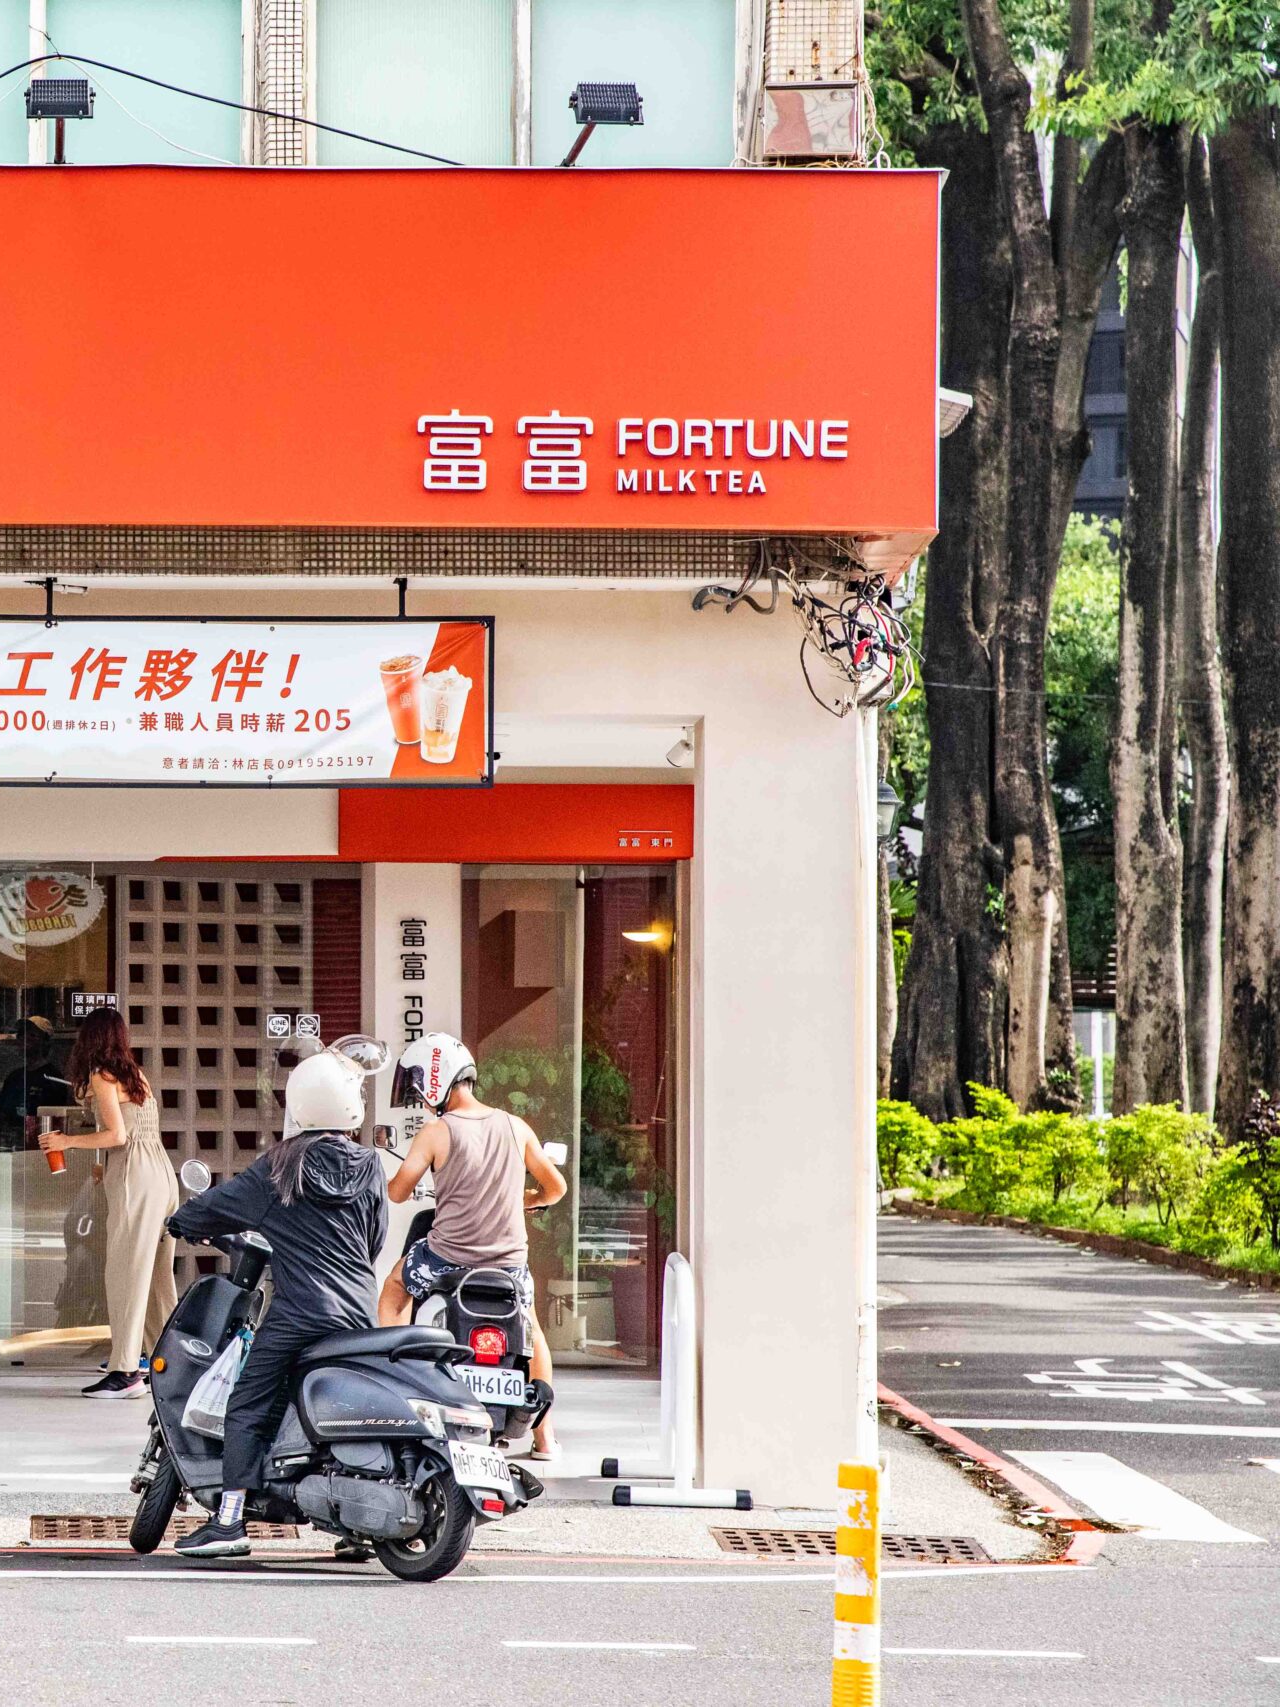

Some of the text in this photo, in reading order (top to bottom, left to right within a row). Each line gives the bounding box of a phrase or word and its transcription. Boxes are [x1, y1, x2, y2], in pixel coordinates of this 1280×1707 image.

[417, 409, 594, 492] 富富
[616, 417, 849, 460] FORTUNE
[617, 469, 767, 494] MILK TEA
[651, 837, 673, 848] 東門
[400, 918, 427, 980] 富富
[75, 995, 116, 1005] 玻璃門請
[427, 1047, 442, 1101] Supreme
[405, 1116, 414, 1140] TEA
[459, 1374, 522, 1396] AH-6160
